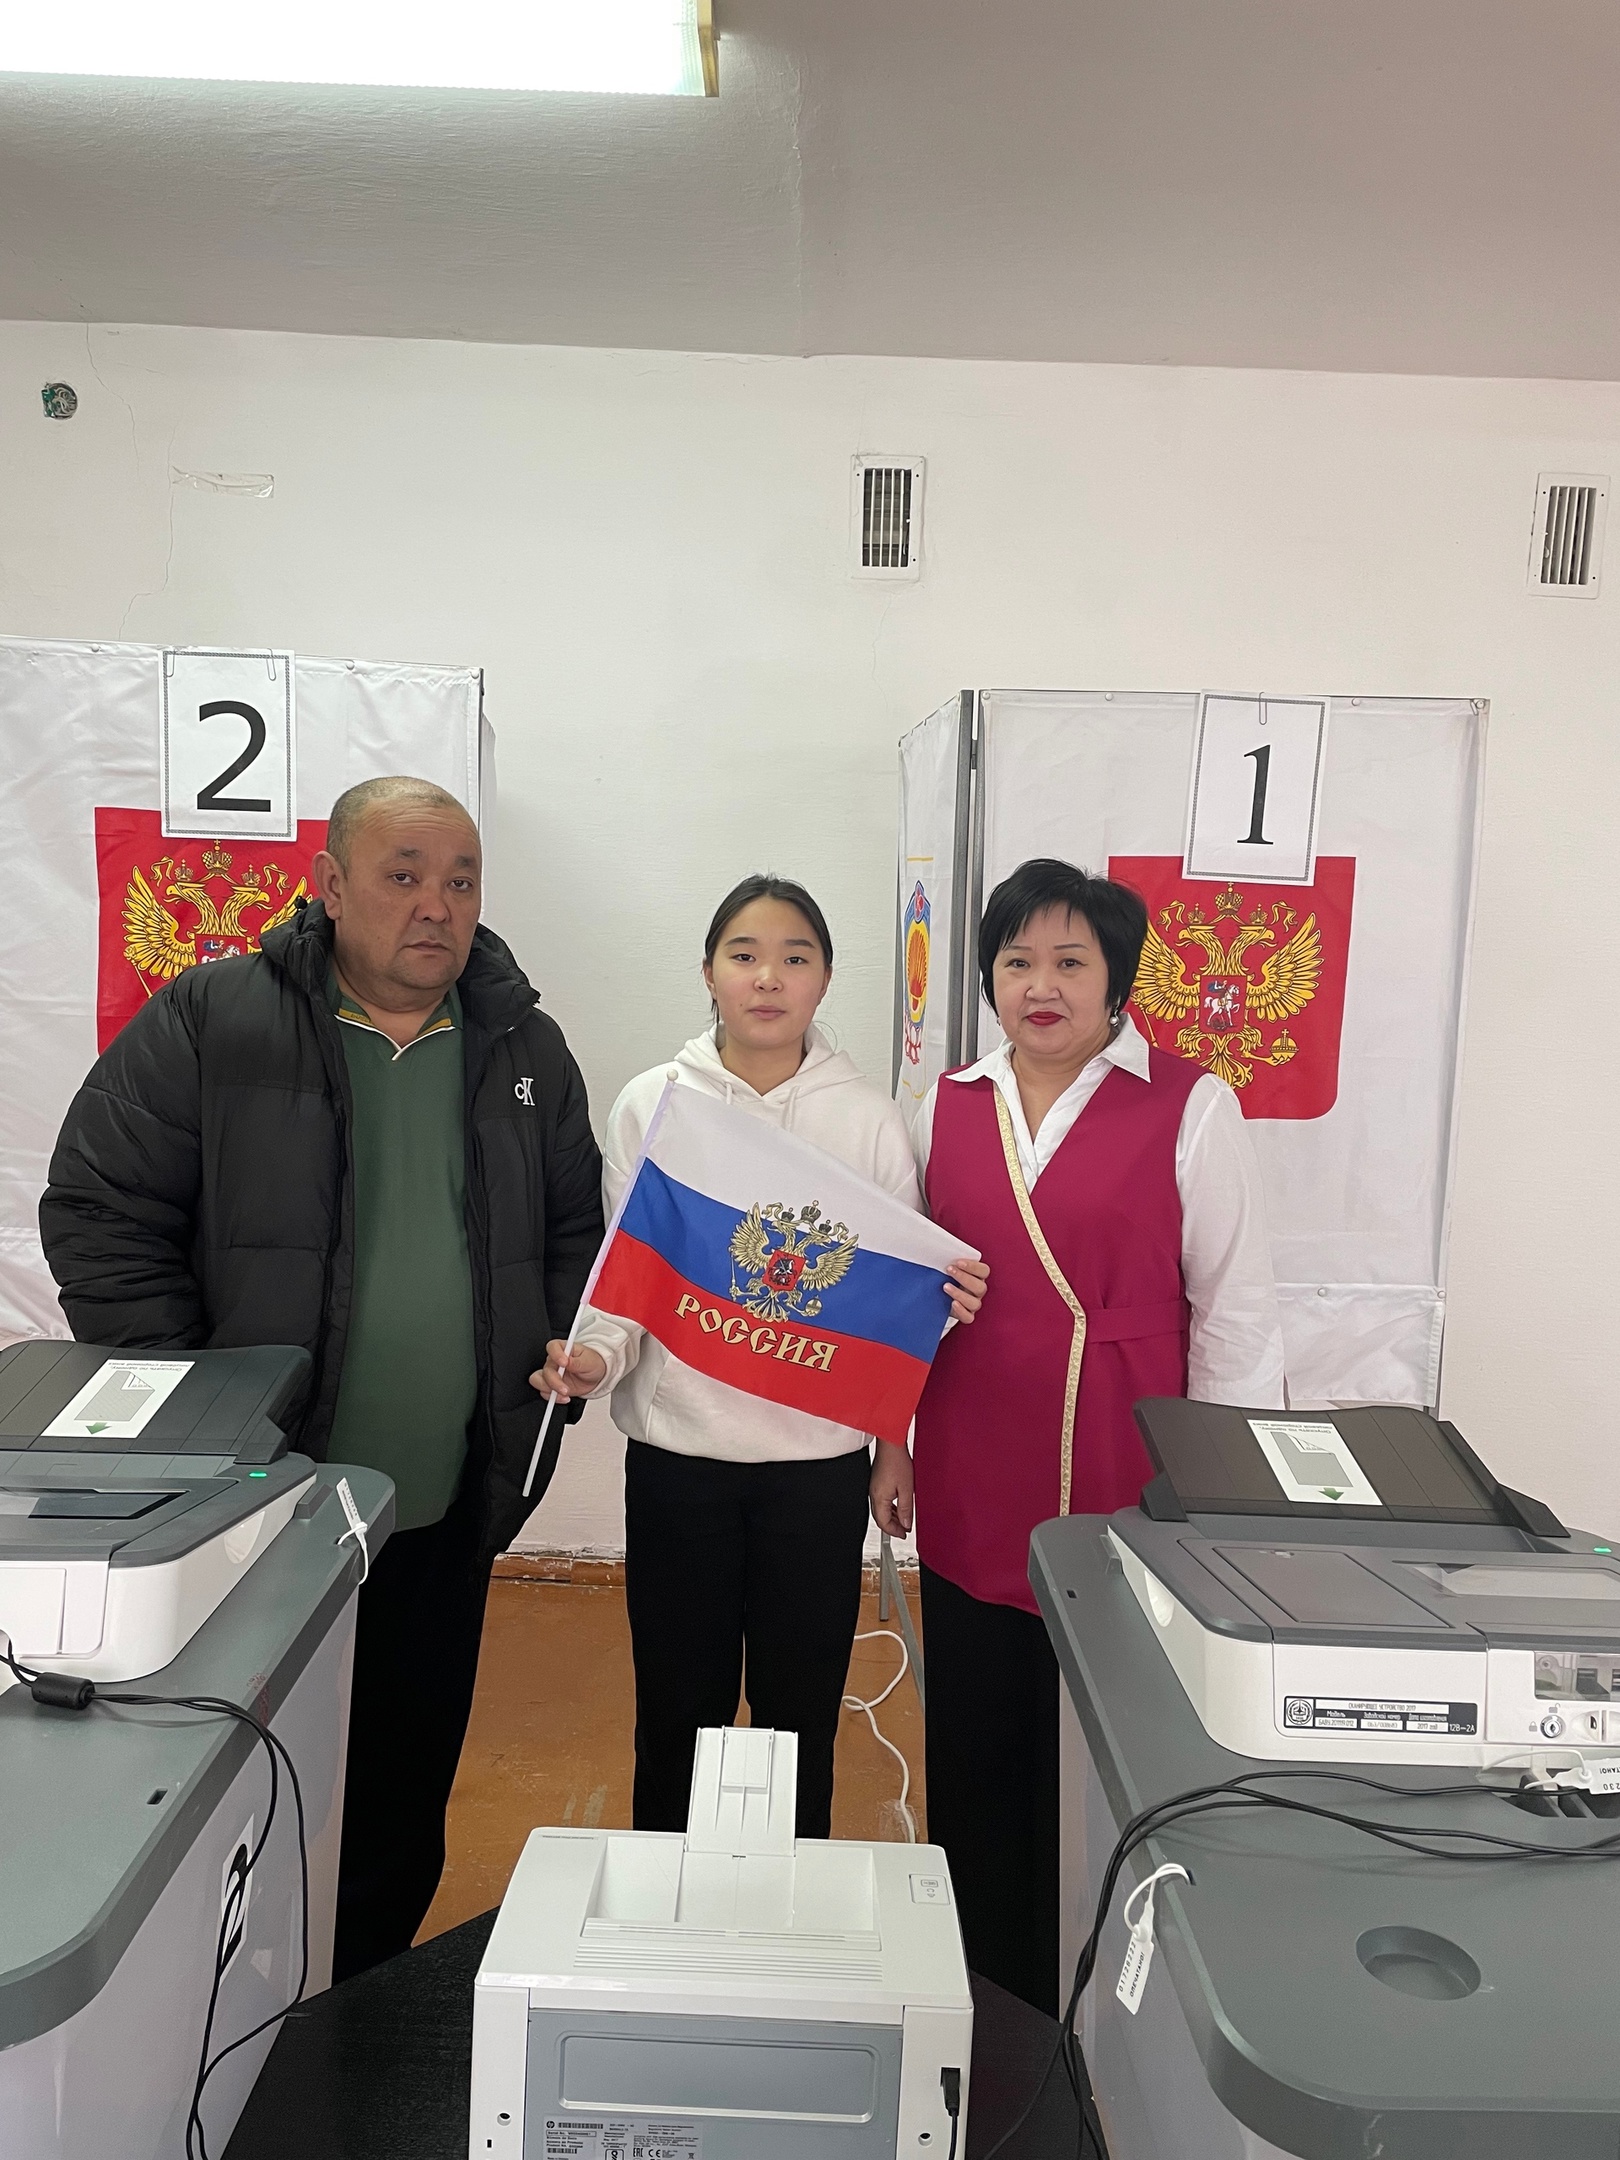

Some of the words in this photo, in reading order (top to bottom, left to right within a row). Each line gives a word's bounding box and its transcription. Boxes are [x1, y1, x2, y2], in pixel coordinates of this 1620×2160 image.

[197, 700, 271, 812] 2
[1237, 744, 1274, 845] 1
[674, 1293, 838, 1372] РОССИЯ
[1599, 1766, 1620, 1775] ТАНО!
